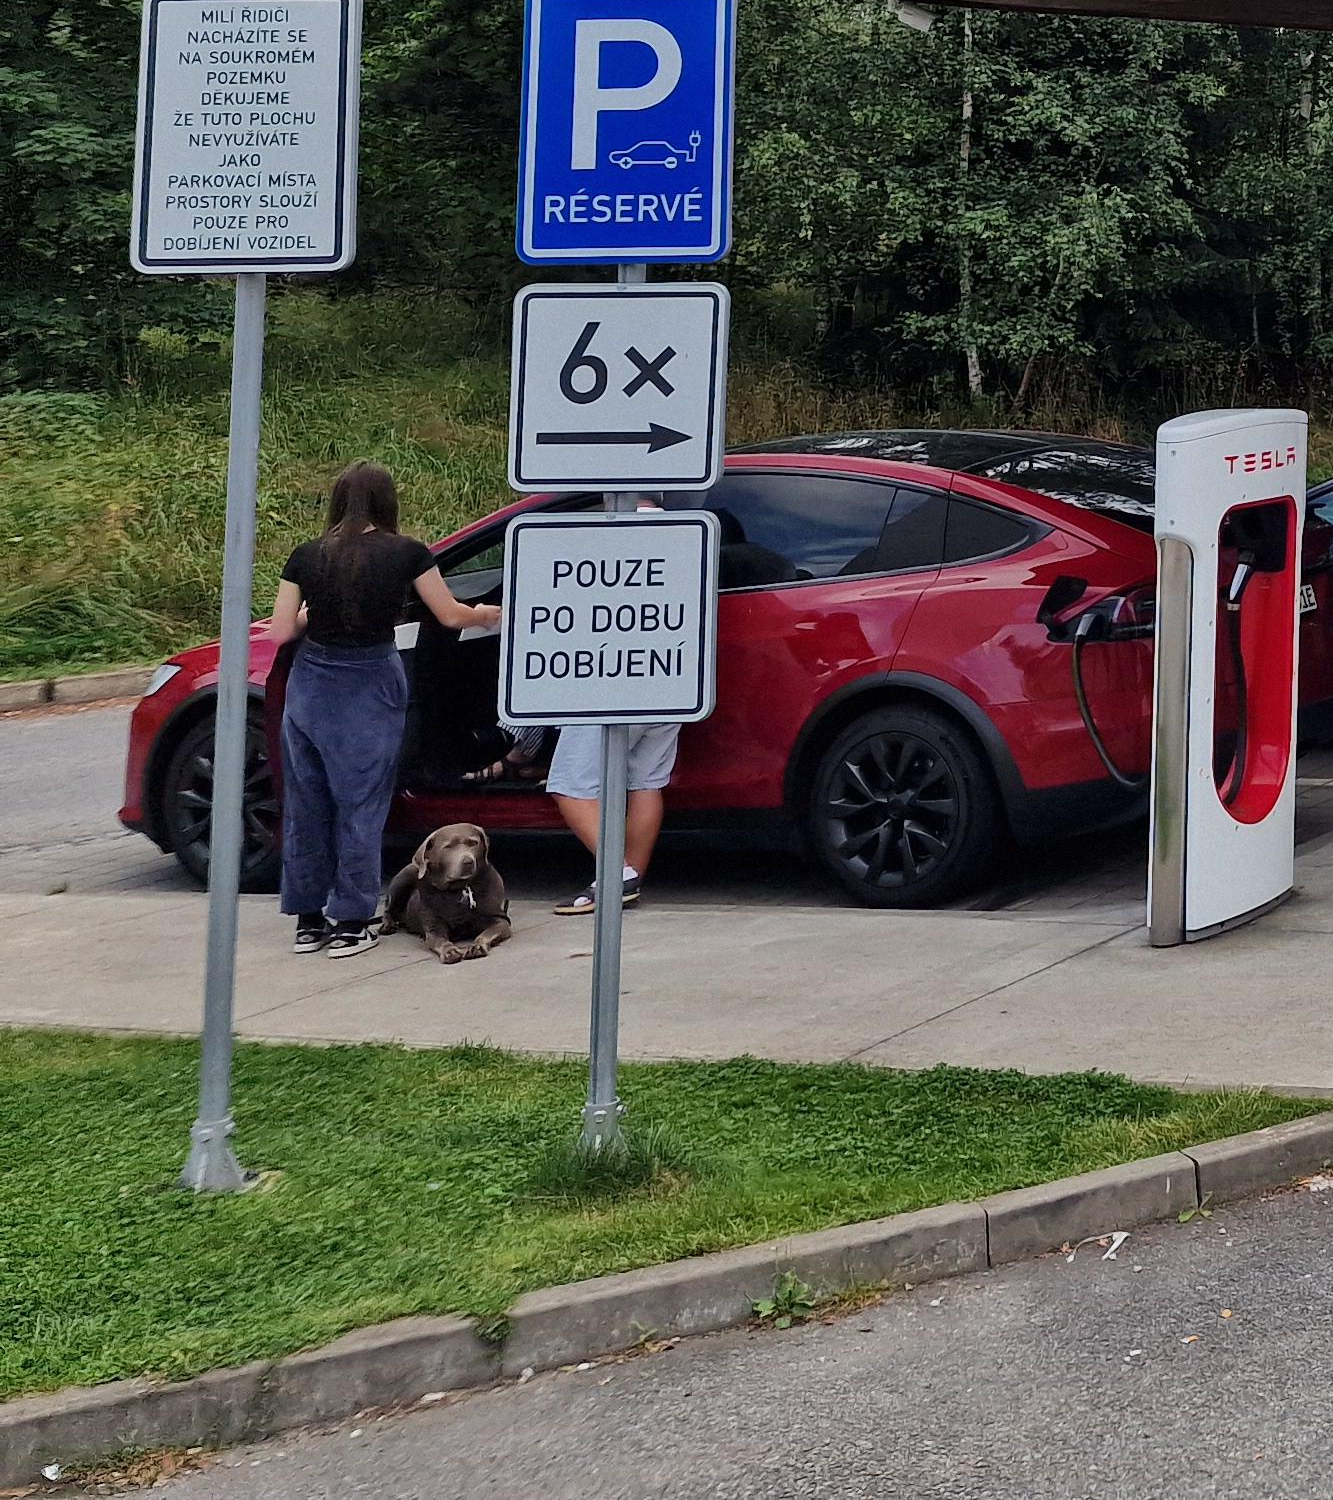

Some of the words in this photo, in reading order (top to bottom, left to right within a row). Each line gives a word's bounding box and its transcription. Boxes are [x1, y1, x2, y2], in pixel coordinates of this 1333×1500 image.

[201, 7, 234, 23] MILÍ
[241, 6, 289, 23] ŘIDIČI
[188, 28, 280, 44] NACHÁZÍTE
[288, 29, 308, 43] SE
[179, 51, 201, 65] NA
[209, 48, 315, 64] SOUKROMÉM
[206, 71, 286, 85] POZEMKU
[201, 90, 290, 106] DĚKUJEME
[571, 19, 682, 170] P
[173, 110, 193, 127] ŽE
[201, 113, 242, 126] TUTO
[250, 112, 315, 125] PLOCHU
[189, 130, 299, 147] NEVYUŽÍVÁTE
[218, 153, 261, 167] JAKO
[168, 172, 261, 188] PARKOVACÍ
[268, 172, 316, 187] MÍSTA
[166, 194, 251, 209] PROSTORY
[259, 191, 319, 208] SLOUŽÍ
[544, 187, 703, 223] RÉSERVÉ
[193, 216, 247, 230] POUZE
[256, 215, 288, 228] PRO
[164, 234, 240, 250] DOBÍJENÍ
[248, 235, 316, 249] VOZIDEL
[1224, 447, 1295, 474] TESLA
[552, 559, 665, 588] POUZE
[530, 605, 574, 634] PO
[591, 603, 685, 632] DOBU
[525, 642, 686, 680] DOBÍJENÍ
